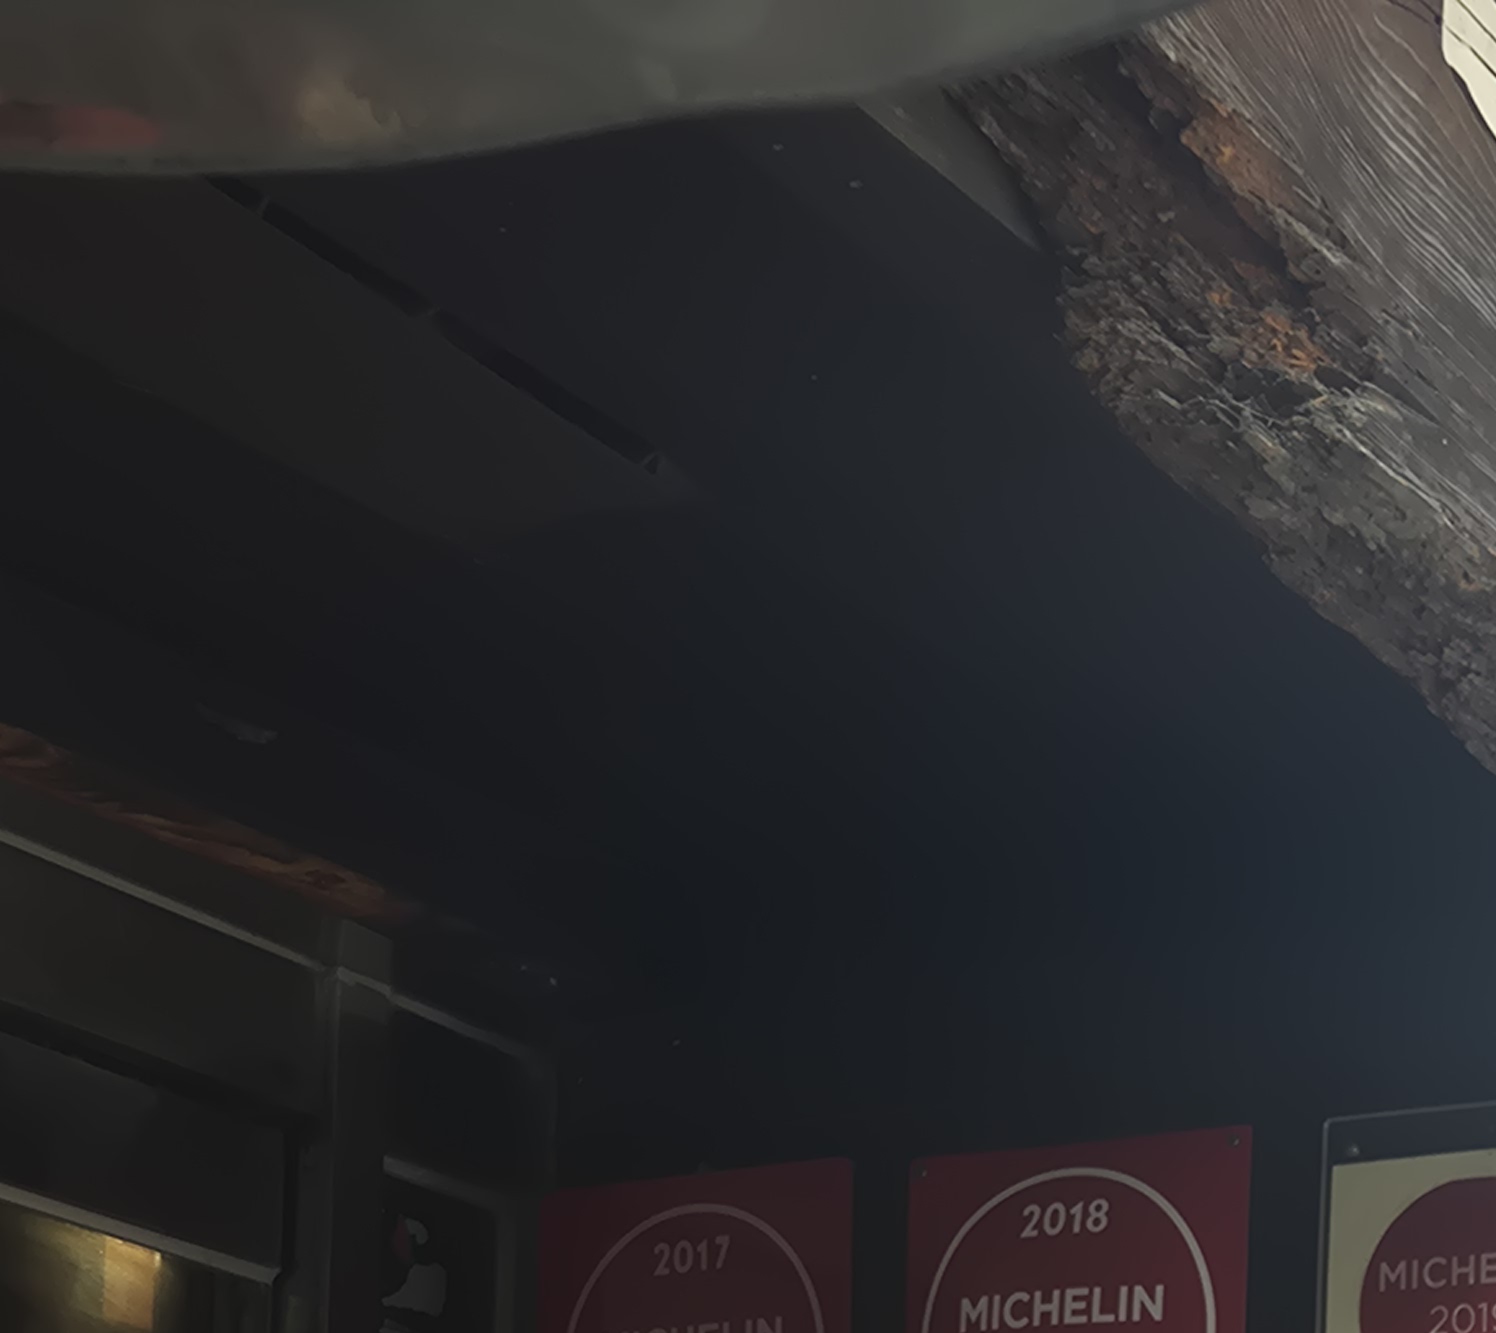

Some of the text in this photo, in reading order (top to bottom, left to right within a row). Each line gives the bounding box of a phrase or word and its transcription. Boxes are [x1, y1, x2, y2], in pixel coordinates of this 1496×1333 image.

[1020, 1198, 1110, 1239] 2018
[652, 1234, 731, 1277] 2017
[959, 1284, 1165, 1333] MICHELIN
